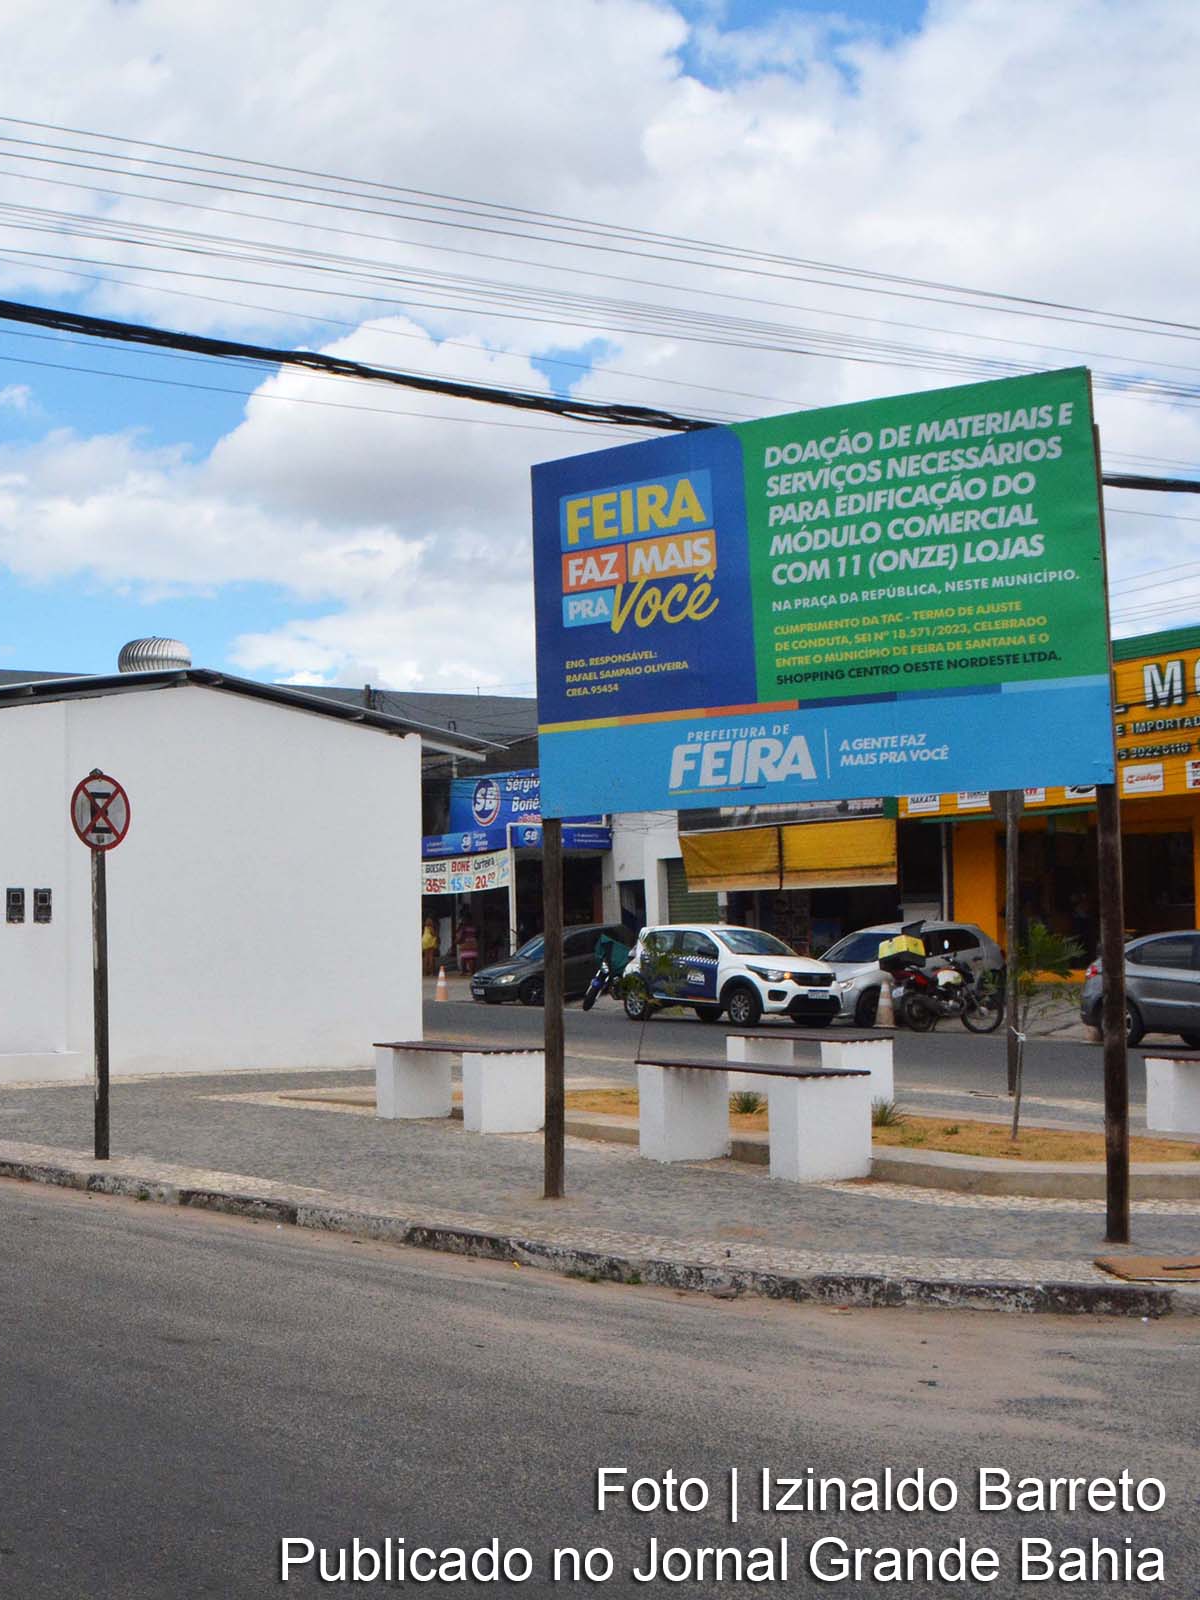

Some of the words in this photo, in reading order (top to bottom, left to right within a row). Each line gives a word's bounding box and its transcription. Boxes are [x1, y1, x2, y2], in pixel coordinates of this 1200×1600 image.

[764, 428, 873, 468] DOAÇÃO
[879, 425, 912, 450] DE
[915, 404, 1053, 445] MATERIAIS
[1057, 402, 1073, 426] E
[766, 460, 882, 497] SERVIÇOS
[886, 436, 1062, 480] NECESSÁRIOS
[566, 478, 706, 545] FEIRA
[768, 499, 831, 527] PARA
[834, 473, 987, 517] EDIFICAÇÃO
[991, 472, 1036, 498] DO
[769, 521, 881, 556] MÓDULO
[887, 503, 1039, 541] COMERCIAL
[568, 552, 619, 587] FAZ
[632, 537, 712, 576] MAIS
[772, 558, 831, 586] COM
[837, 554, 861, 577] 11
[869, 543, 958, 579] (ONZE)
[963, 534, 1045, 564] LOJAS
[568, 597, 610, 621] PRA
[610, 568, 719, 634] Você
[772, 600, 792, 612] NA
[794, 595, 837, 609] PRAÇA
[840, 592, 858, 604] DA
[861, 583, 942, 601] REPÚBLICA,
[945, 578, 988, 593] NESTE
[992, 569, 1080, 588] MUNICÍPIO.
[774, 617, 860, 635] CUMPRIMENTO
[862, 615, 879, 626] DA
[882, 613, 903, 624] TAC
[912, 608, 955, 620] TERMO
[958, 605, 973, 616] DE
[976, 601, 1022, 615] AJUSTE
[775, 640, 789, 651] DE
[792, 635, 852, 650] CONDUTA,
[854, 633, 871, 644] SEI
[974, 616, 1047, 632] CELEBRADO
[565, 659, 586, 669] ENG.
[589, 650, 658, 667] RESPONSÁVEL:
[775, 655, 811, 668] ENTRE
[812, 653, 822, 664] O
[825, 647, 890, 663] MUNICÍPIO
[893, 645, 908, 656] DE
[911, 642, 945, 654] FEIRA
[946, 640, 962, 650] DE
[965, 635, 1026, 650] SANTANA
[1029, 633, 1036, 644] E
[1038, 632, 1050, 643] O
[776, 669, 845, 685] SHOPPING
[848, 663, 900, 678] CENTRO
[903, 659, 944, 673] OESTE
[946, 653, 1019, 670] NORDESTE
[1022, 650, 1062, 663] LTDA.
[565, 671, 599, 683] RAFAEL
[599, 666, 642, 680] SAMPAIO
[643, 660, 689, 674] OLIVEIRA
[687, 727, 767, 742] PREFEITURA
[772, 724, 790, 736] DE
[839, 739, 851, 752] A
[851, 735, 899, 750] GENTE
[900, 733, 927, 747] FAZ
[669, 735, 817, 789] FEIRA
[839, 753, 878, 767] MAIS
[878, 750, 908, 764] PRA
[909, 744, 950, 761] VOCÊ
[474, 787, 497, 812] SB
[511, 794, 541, 813] Boné
[524, 830, 538, 841] SB
